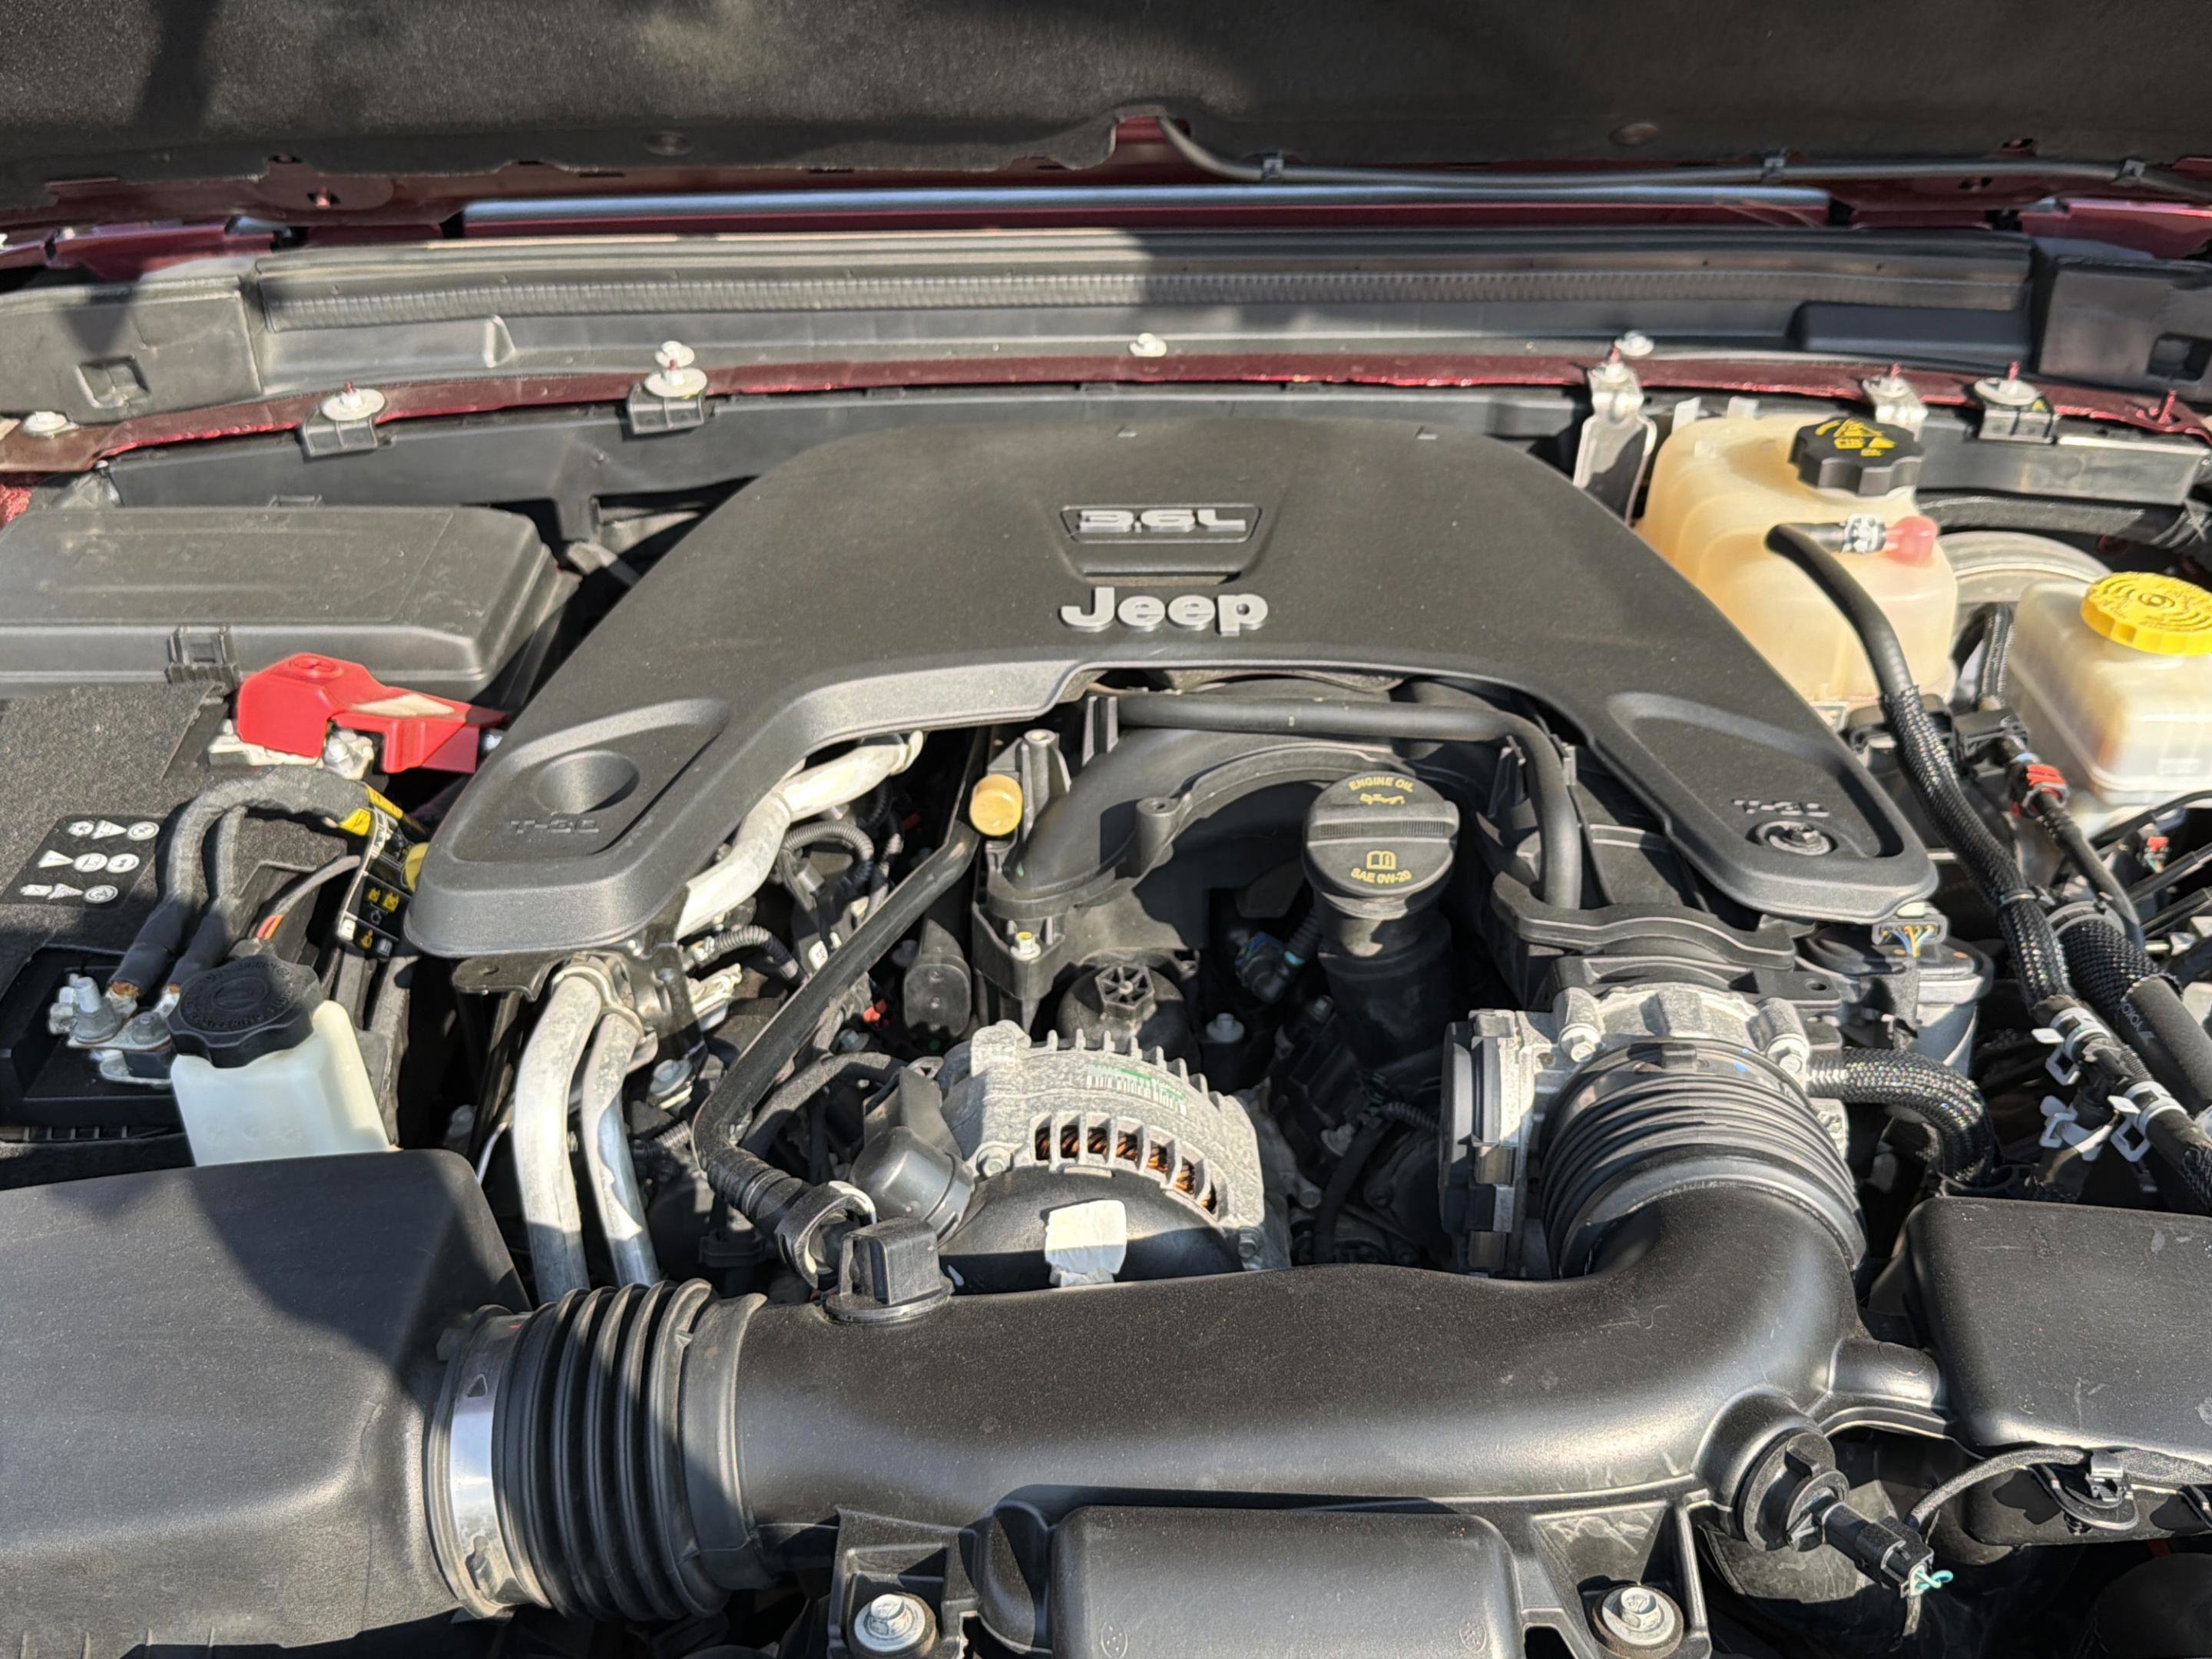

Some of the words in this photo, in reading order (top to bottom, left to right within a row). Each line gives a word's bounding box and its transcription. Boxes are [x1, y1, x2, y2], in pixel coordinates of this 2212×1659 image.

[1078, 508, 1247, 533] 3.6L
[1060, 586, 1269, 637] Jeep
[1349, 777, 1394, 791] ENGINE
[1395, 778, 1414, 793] OIL
[1350, 867, 1376, 883] SAE
